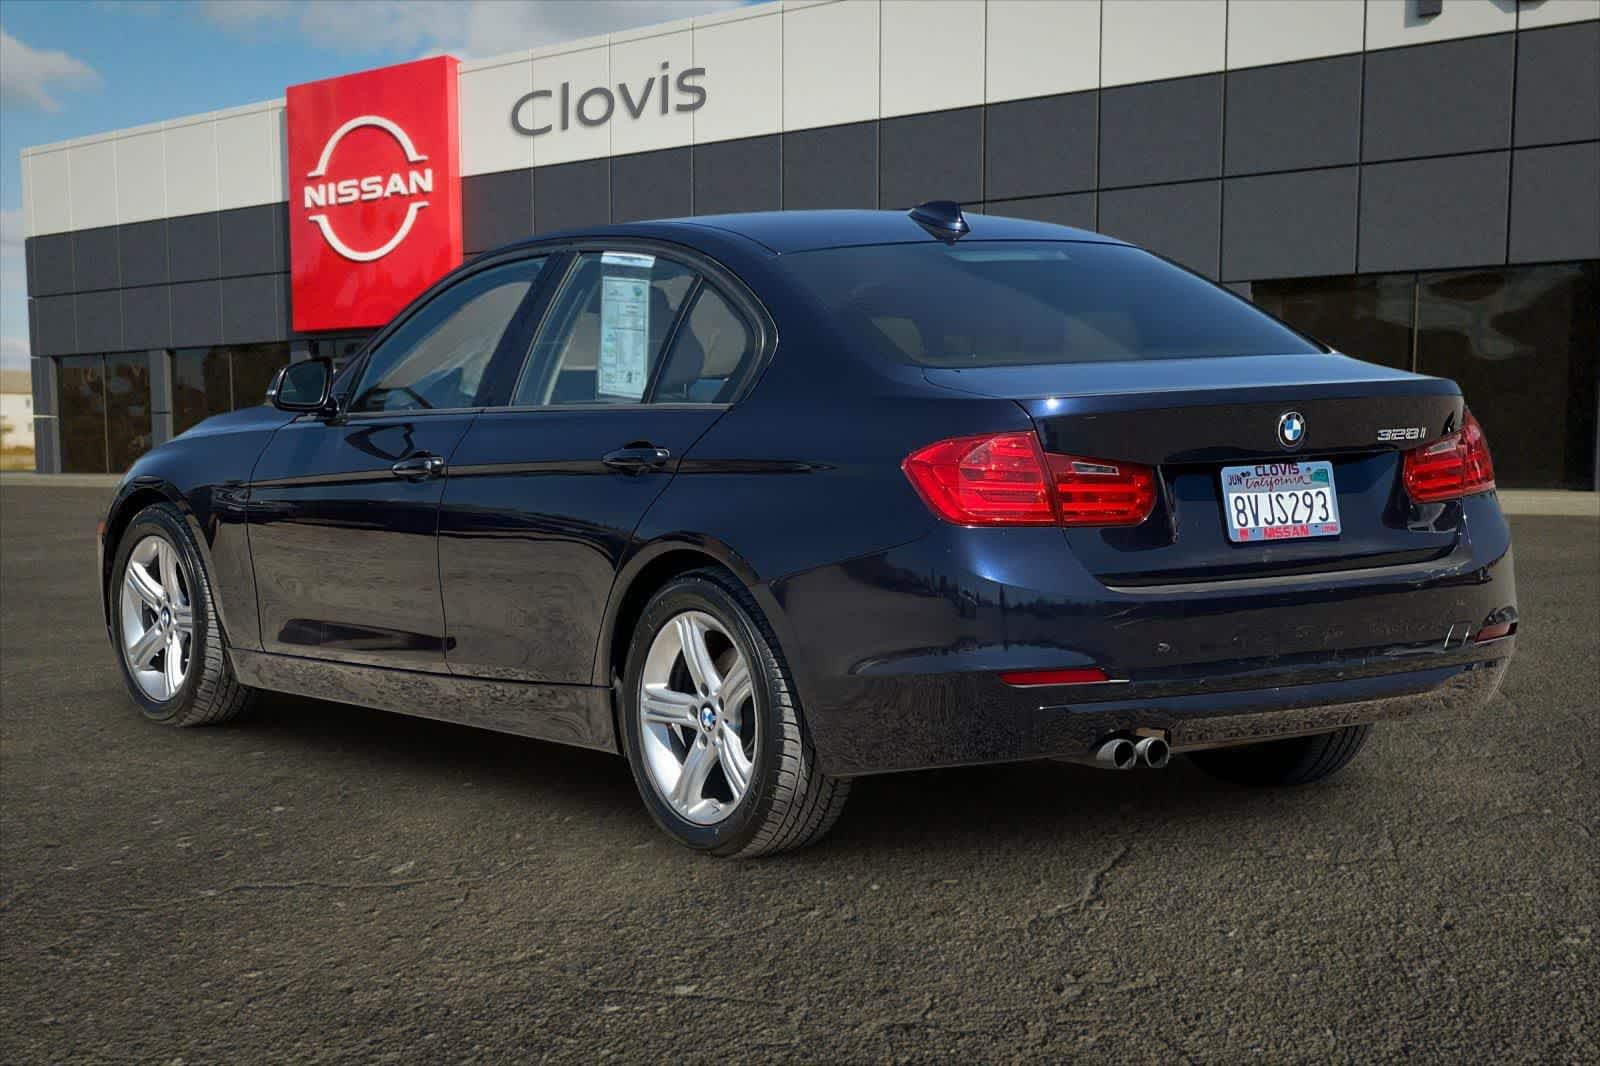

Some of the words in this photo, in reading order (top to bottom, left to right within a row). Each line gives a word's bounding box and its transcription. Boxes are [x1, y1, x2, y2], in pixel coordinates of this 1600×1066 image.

[511, 62, 707, 136] Clovis
[304, 168, 433, 208] NISSAN
[1377, 426, 1426, 441] 328i
[1255, 463, 1300, 477] CLOVIS
[1245, 475, 1312, 491] California
[1234, 491, 1329, 527] 8VJS293
[1263, 525, 1310, 538] NISSAN
